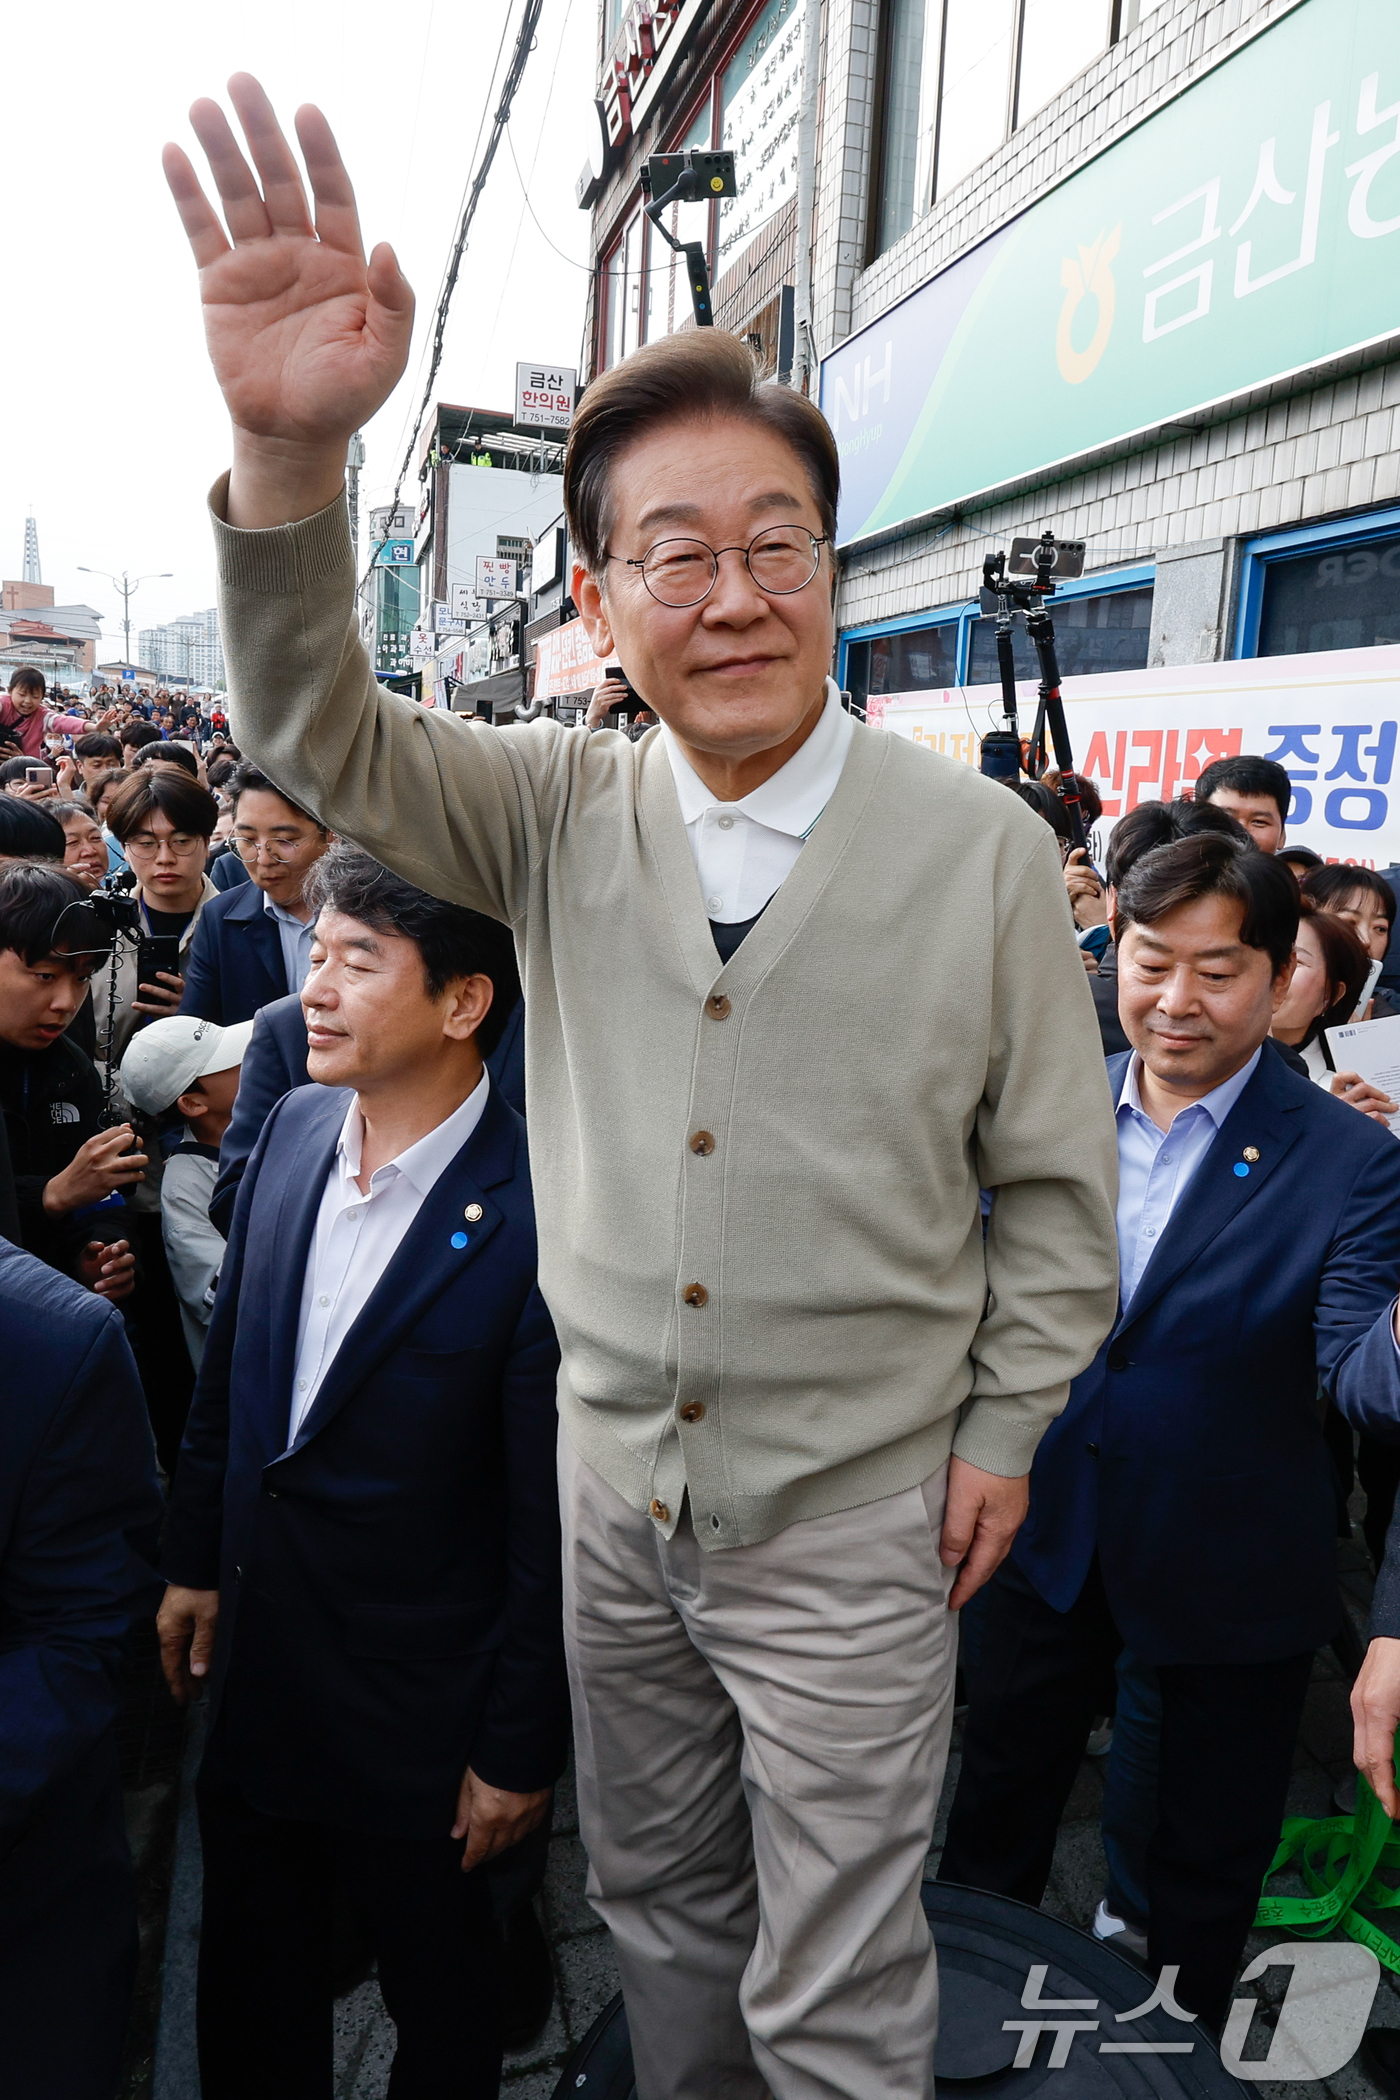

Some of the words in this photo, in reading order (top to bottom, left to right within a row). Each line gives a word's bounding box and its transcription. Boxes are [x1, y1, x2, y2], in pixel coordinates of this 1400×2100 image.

[530, 371, 563, 391] 금산
[834, 341, 893, 433] NH
[522, 390, 570, 412] 한의원
[521, 411, 527, 420] T
[530, 412, 570, 426] 751-7582
[837, 423, 883, 457] NongHyup
[393, 546, 408, 560] 현
[418, 633, 428, 643] 옷
[414, 645, 432, 655] 수선
[565, 696, 571, 704] T
[1264, 721, 1398, 830] 증정
